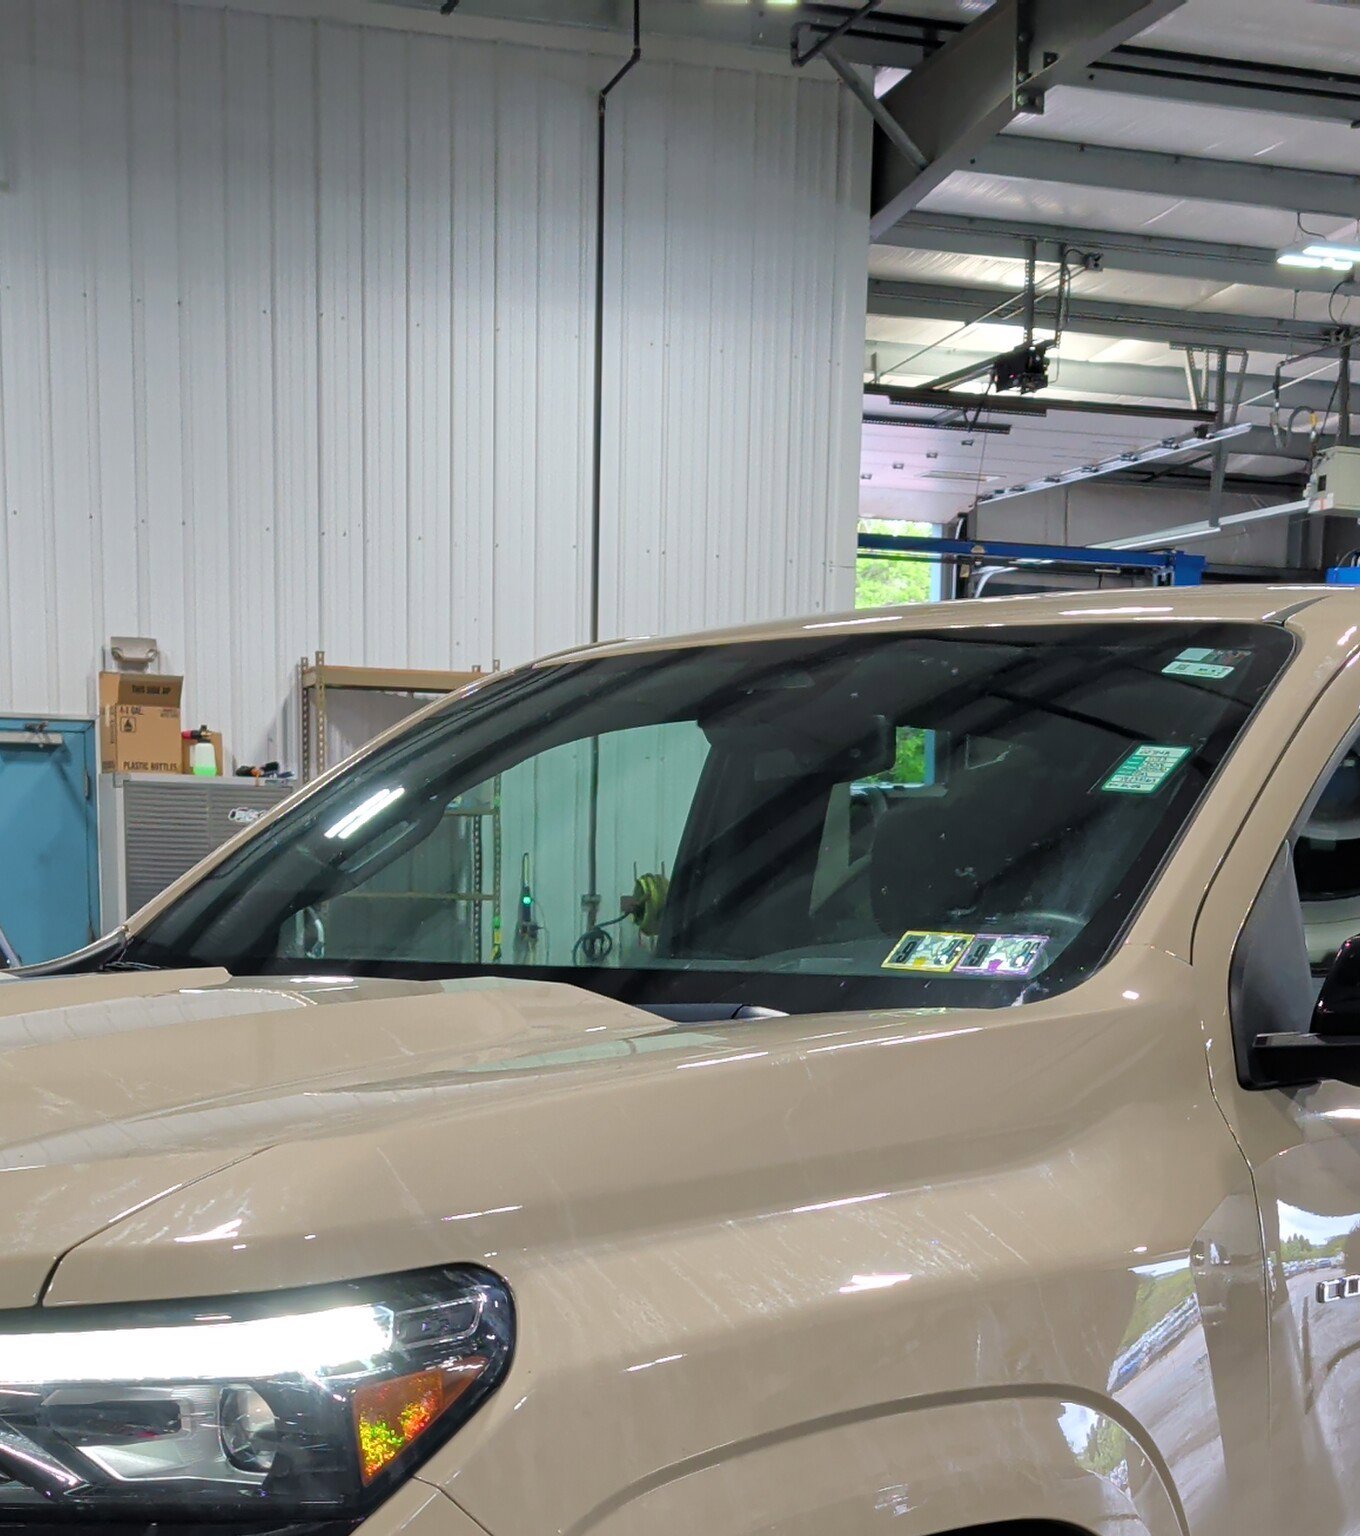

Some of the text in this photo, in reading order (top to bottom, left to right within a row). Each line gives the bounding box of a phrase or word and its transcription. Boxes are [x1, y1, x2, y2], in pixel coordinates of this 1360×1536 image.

[123, 761, 148, 771] PLASTIC
[150, 762, 177, 771] BOTTLES
[895, 941, 918, 963] 9
[968, 944, 990, 967] 9
